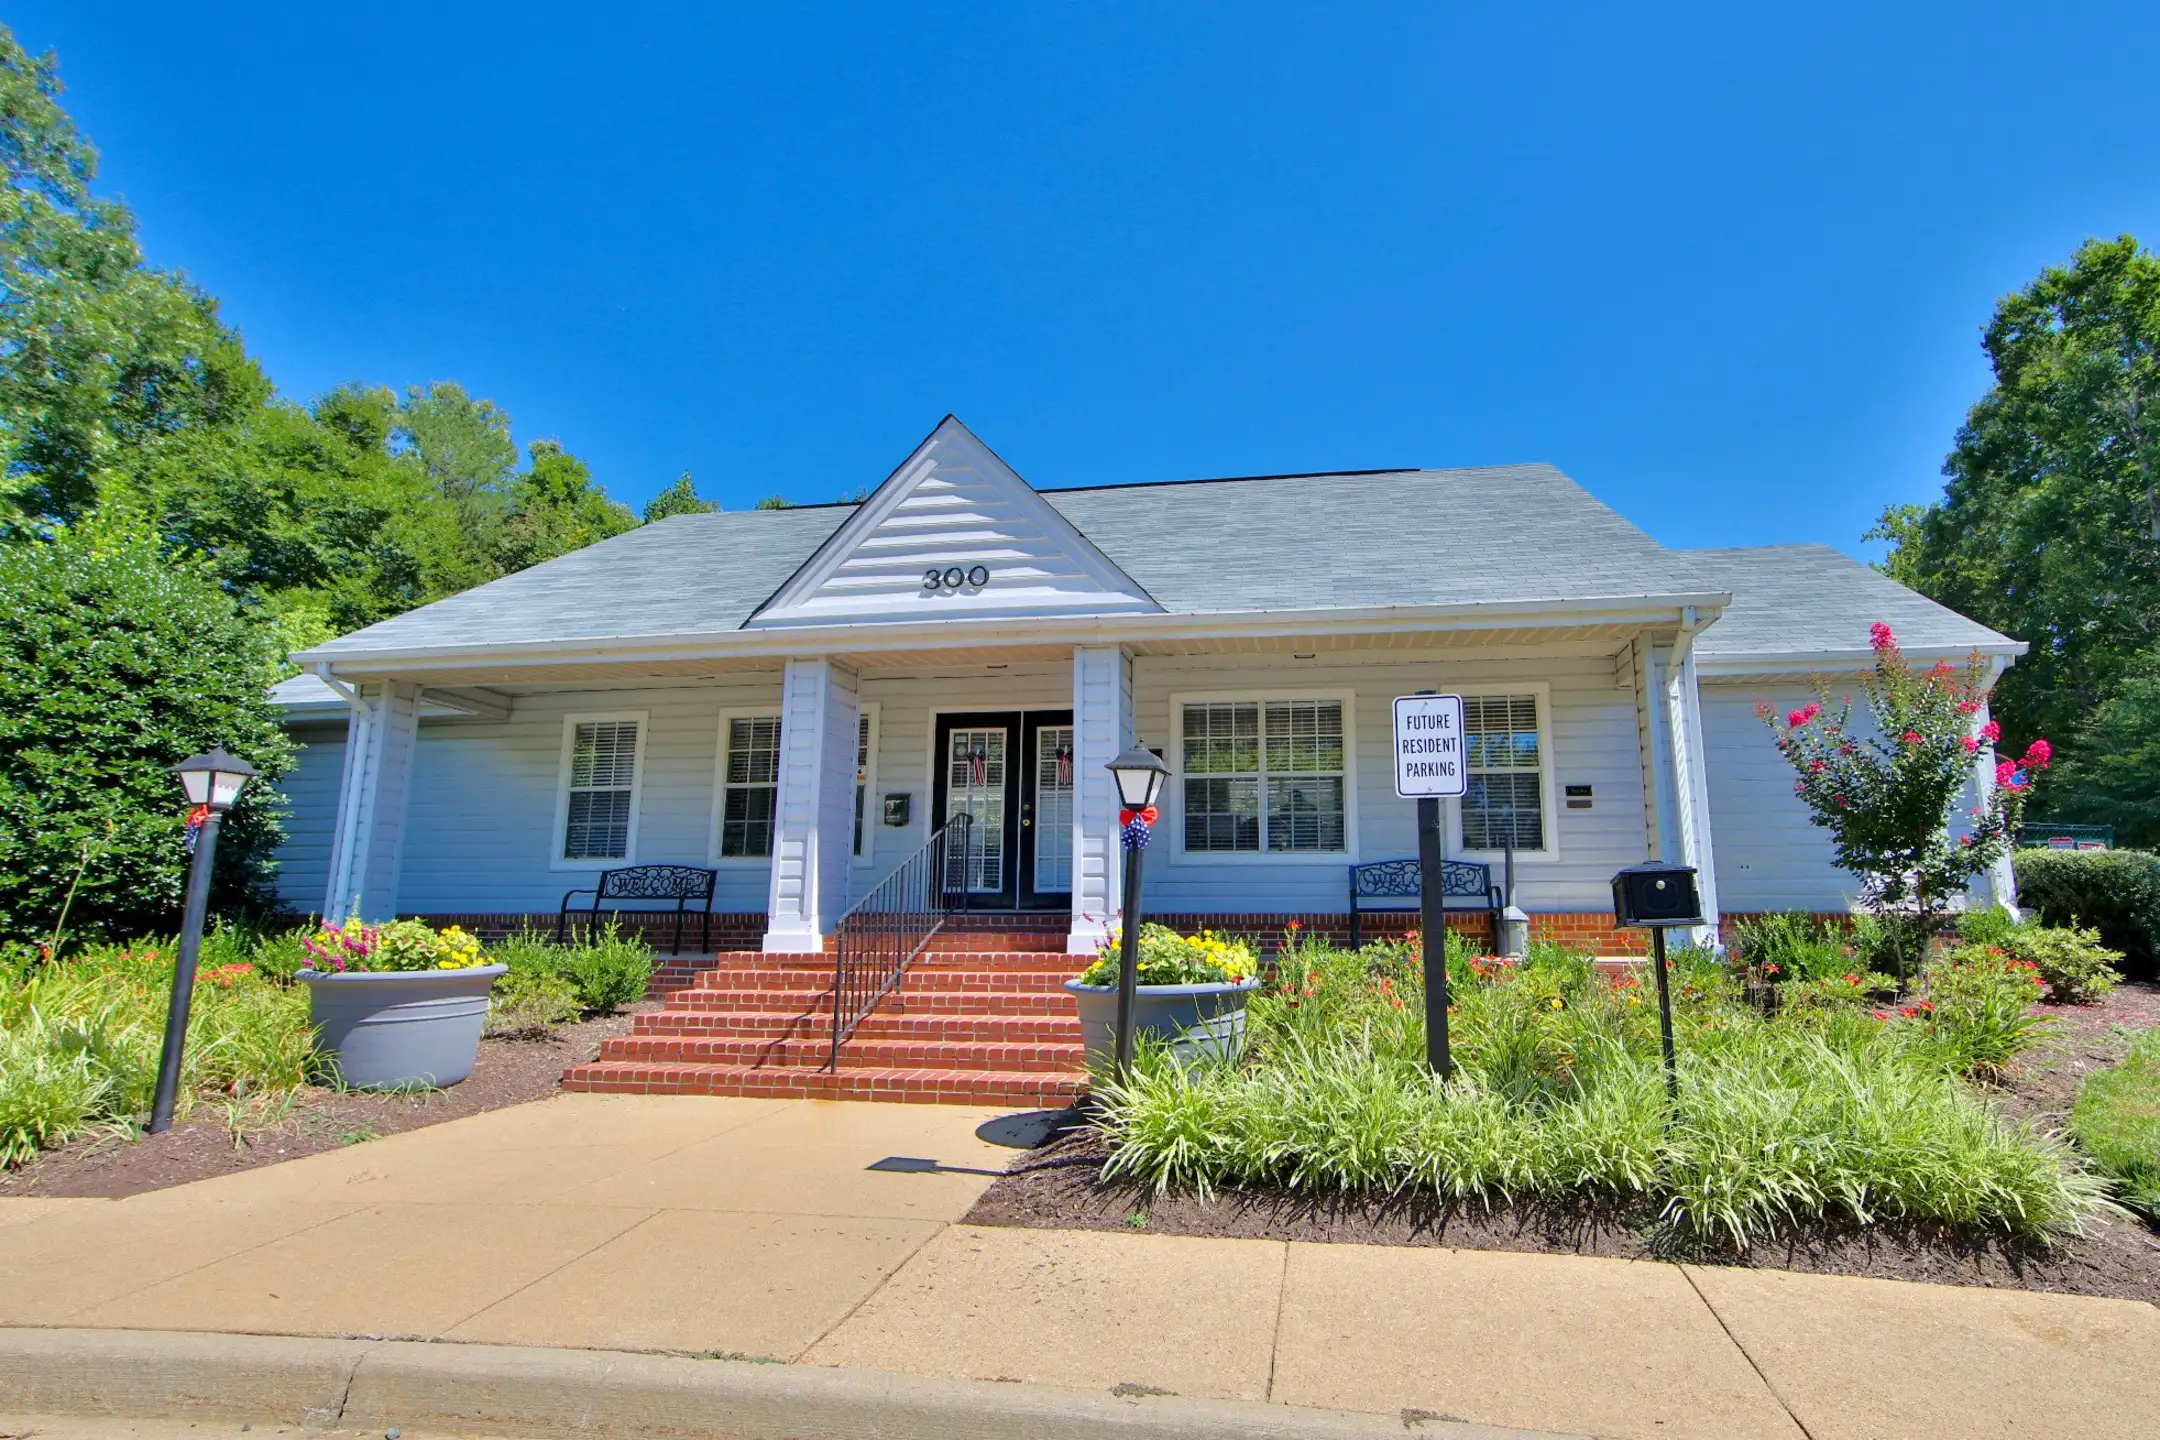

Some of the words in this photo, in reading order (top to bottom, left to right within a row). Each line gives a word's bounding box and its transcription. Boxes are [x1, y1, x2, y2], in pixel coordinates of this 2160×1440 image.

[923, 565, 990, 590] 300
[1406, 714, 1451, 730] FUTURE
[1402, 737, 1457, 754] RESIDENT
[1406, 761, 1456, 778] PARKING
[619, 876, 694, 891] WELCOME
[1372, 872, 1465, 886] WELCME
